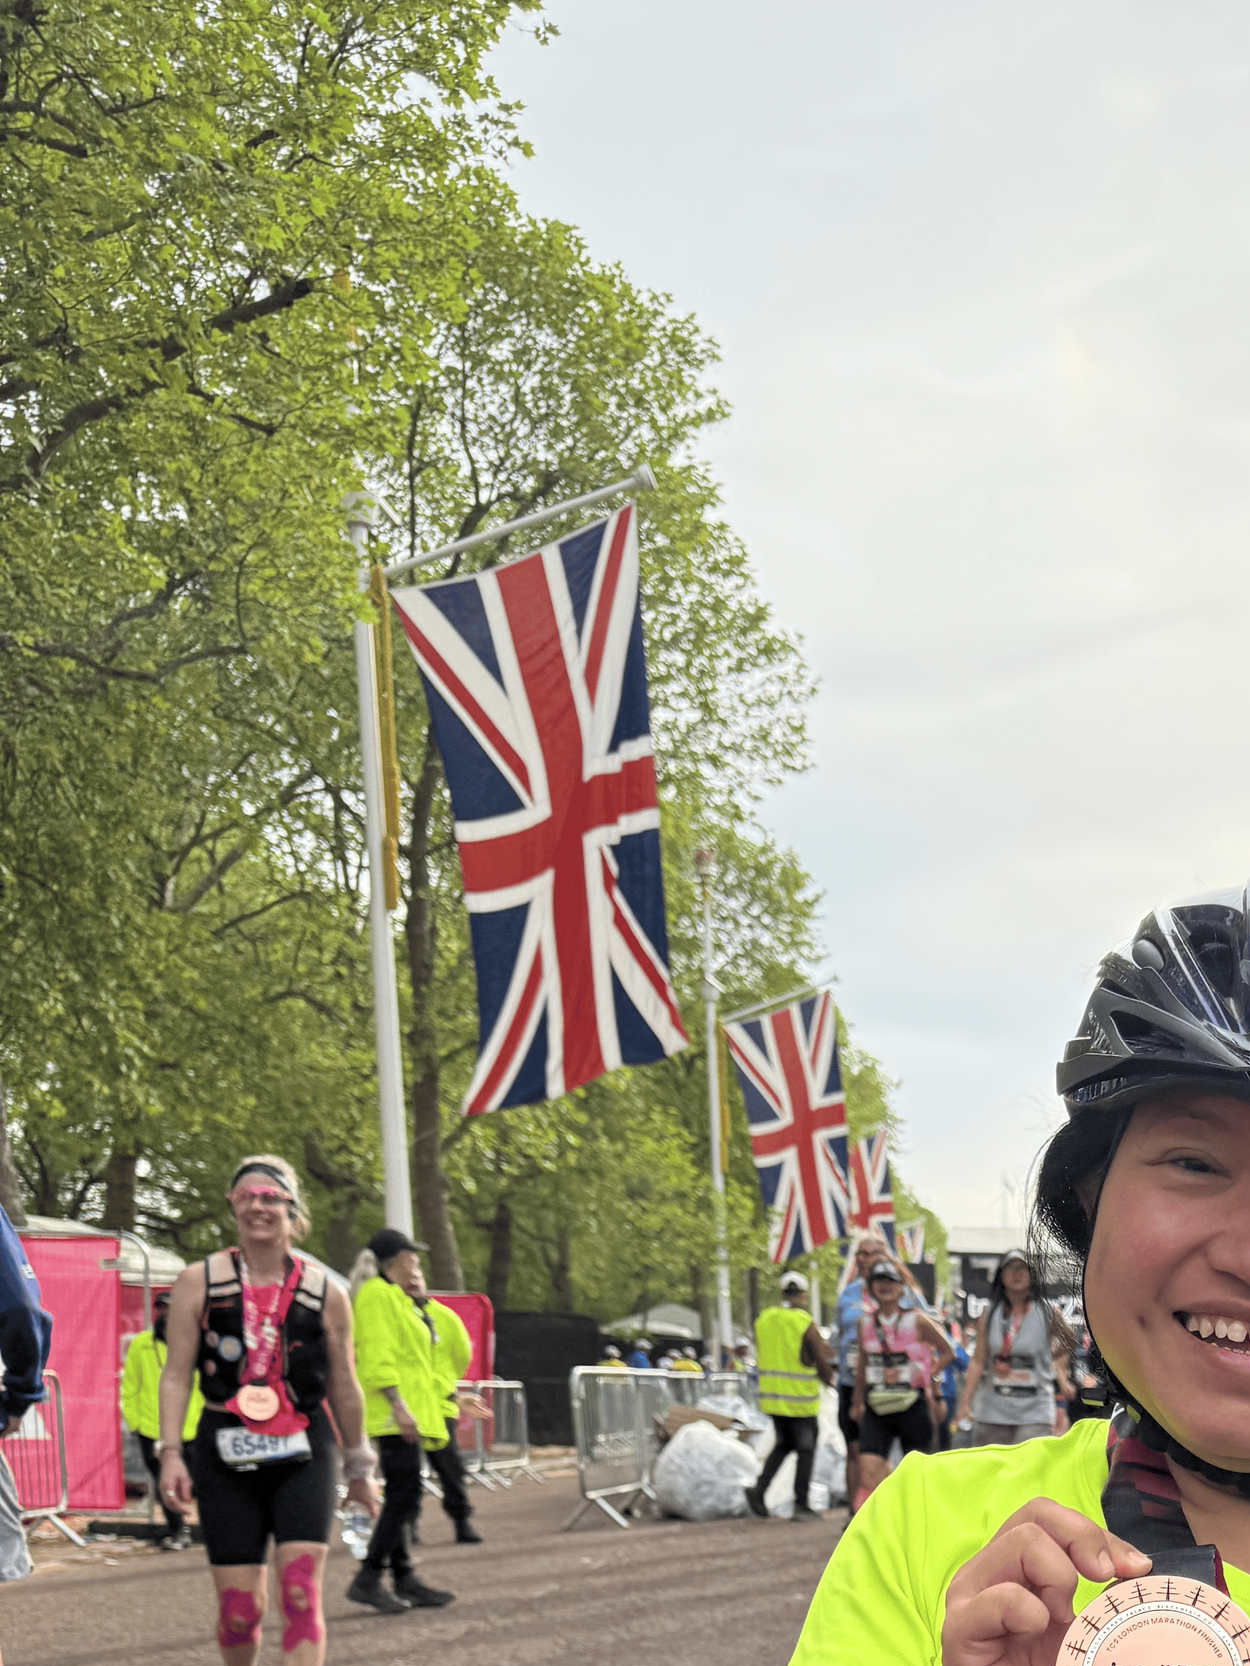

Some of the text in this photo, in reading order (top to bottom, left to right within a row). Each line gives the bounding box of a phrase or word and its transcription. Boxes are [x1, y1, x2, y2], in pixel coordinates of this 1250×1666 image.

[1106, 1616, 1223, 1659] TCS LONDON MARATHON FINISHER
